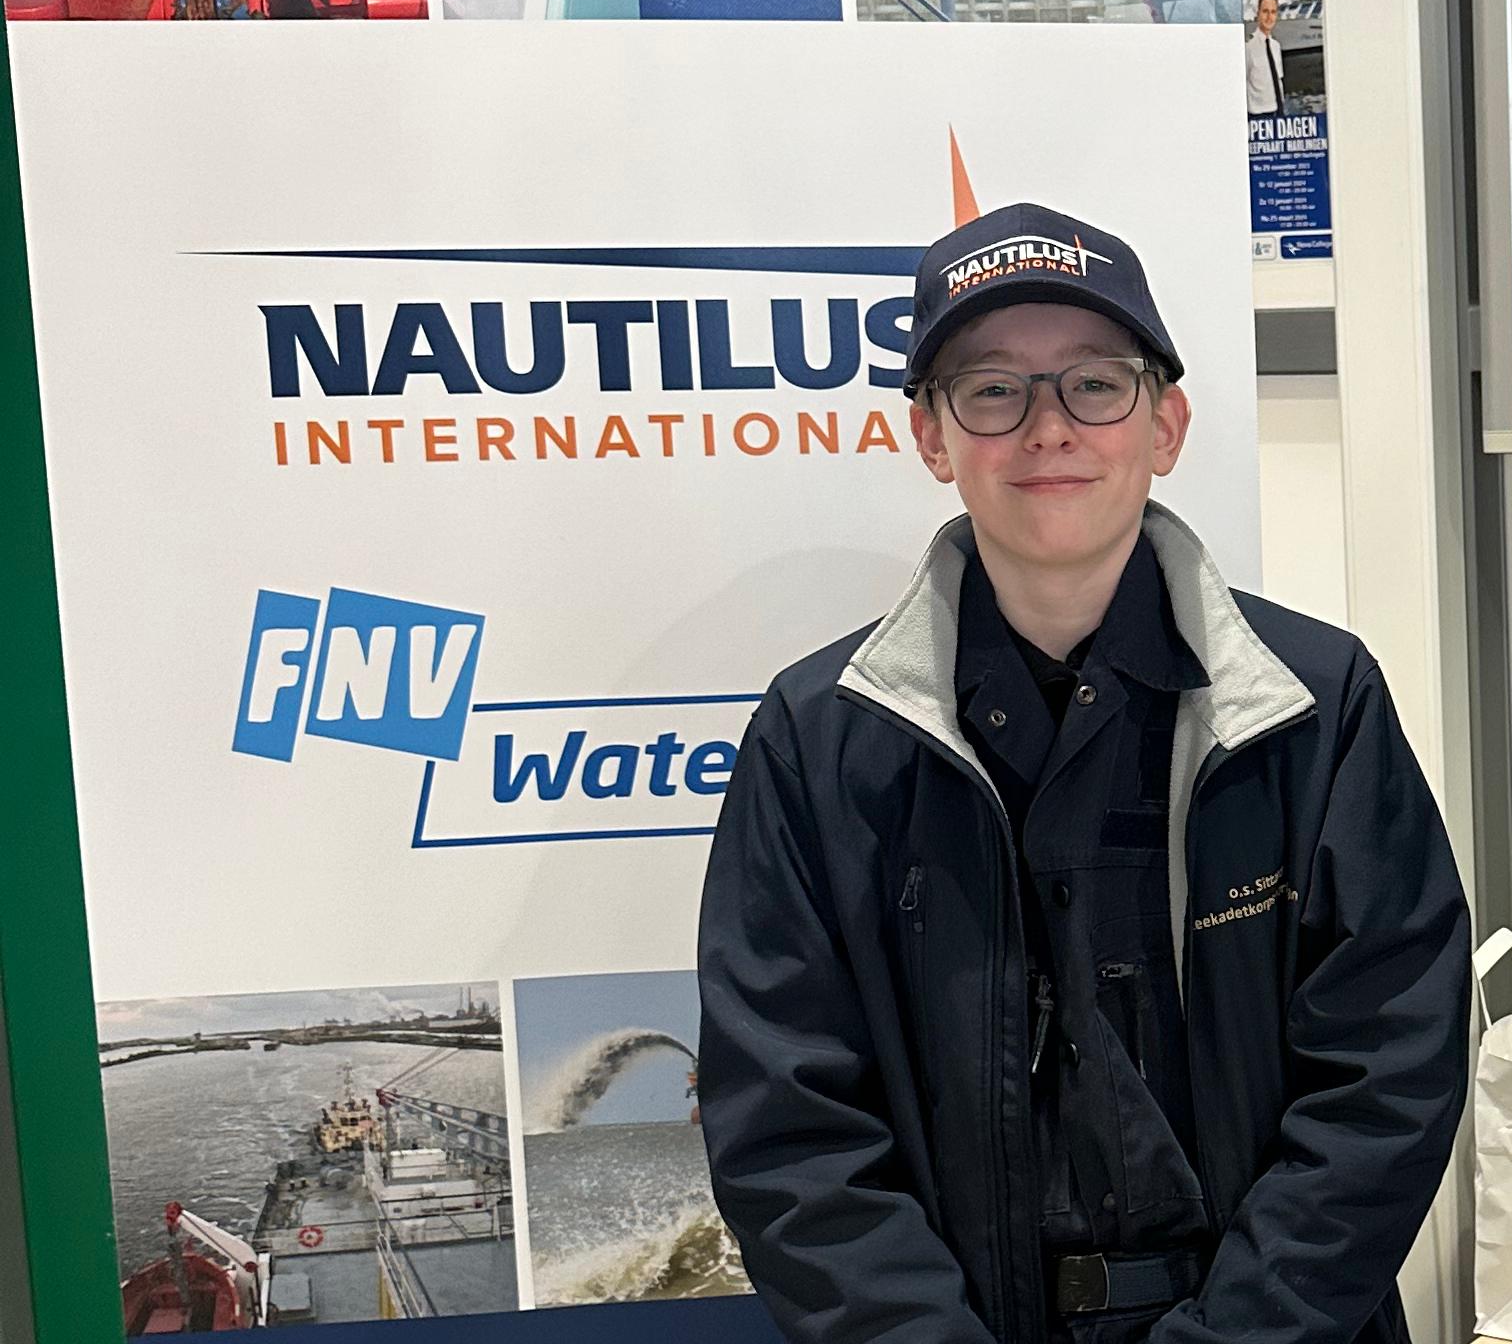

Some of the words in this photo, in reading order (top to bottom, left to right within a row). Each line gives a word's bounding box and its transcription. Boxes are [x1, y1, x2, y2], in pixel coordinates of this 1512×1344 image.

[1250, 118, 1274, 140] PEN
[1277, 116, 1317, 139] DAGEN
[947, 243, 1079, 289] NAUTILUS
[949, 259, 1080, 300] INTERNATIONAL
[258, 297, 917, 400] NAUTILUS
[275, 409, 900, 468] INTERNATIONA
[247, 623, 475, 725] FNV
[492, 733, 743, 808] Wate
